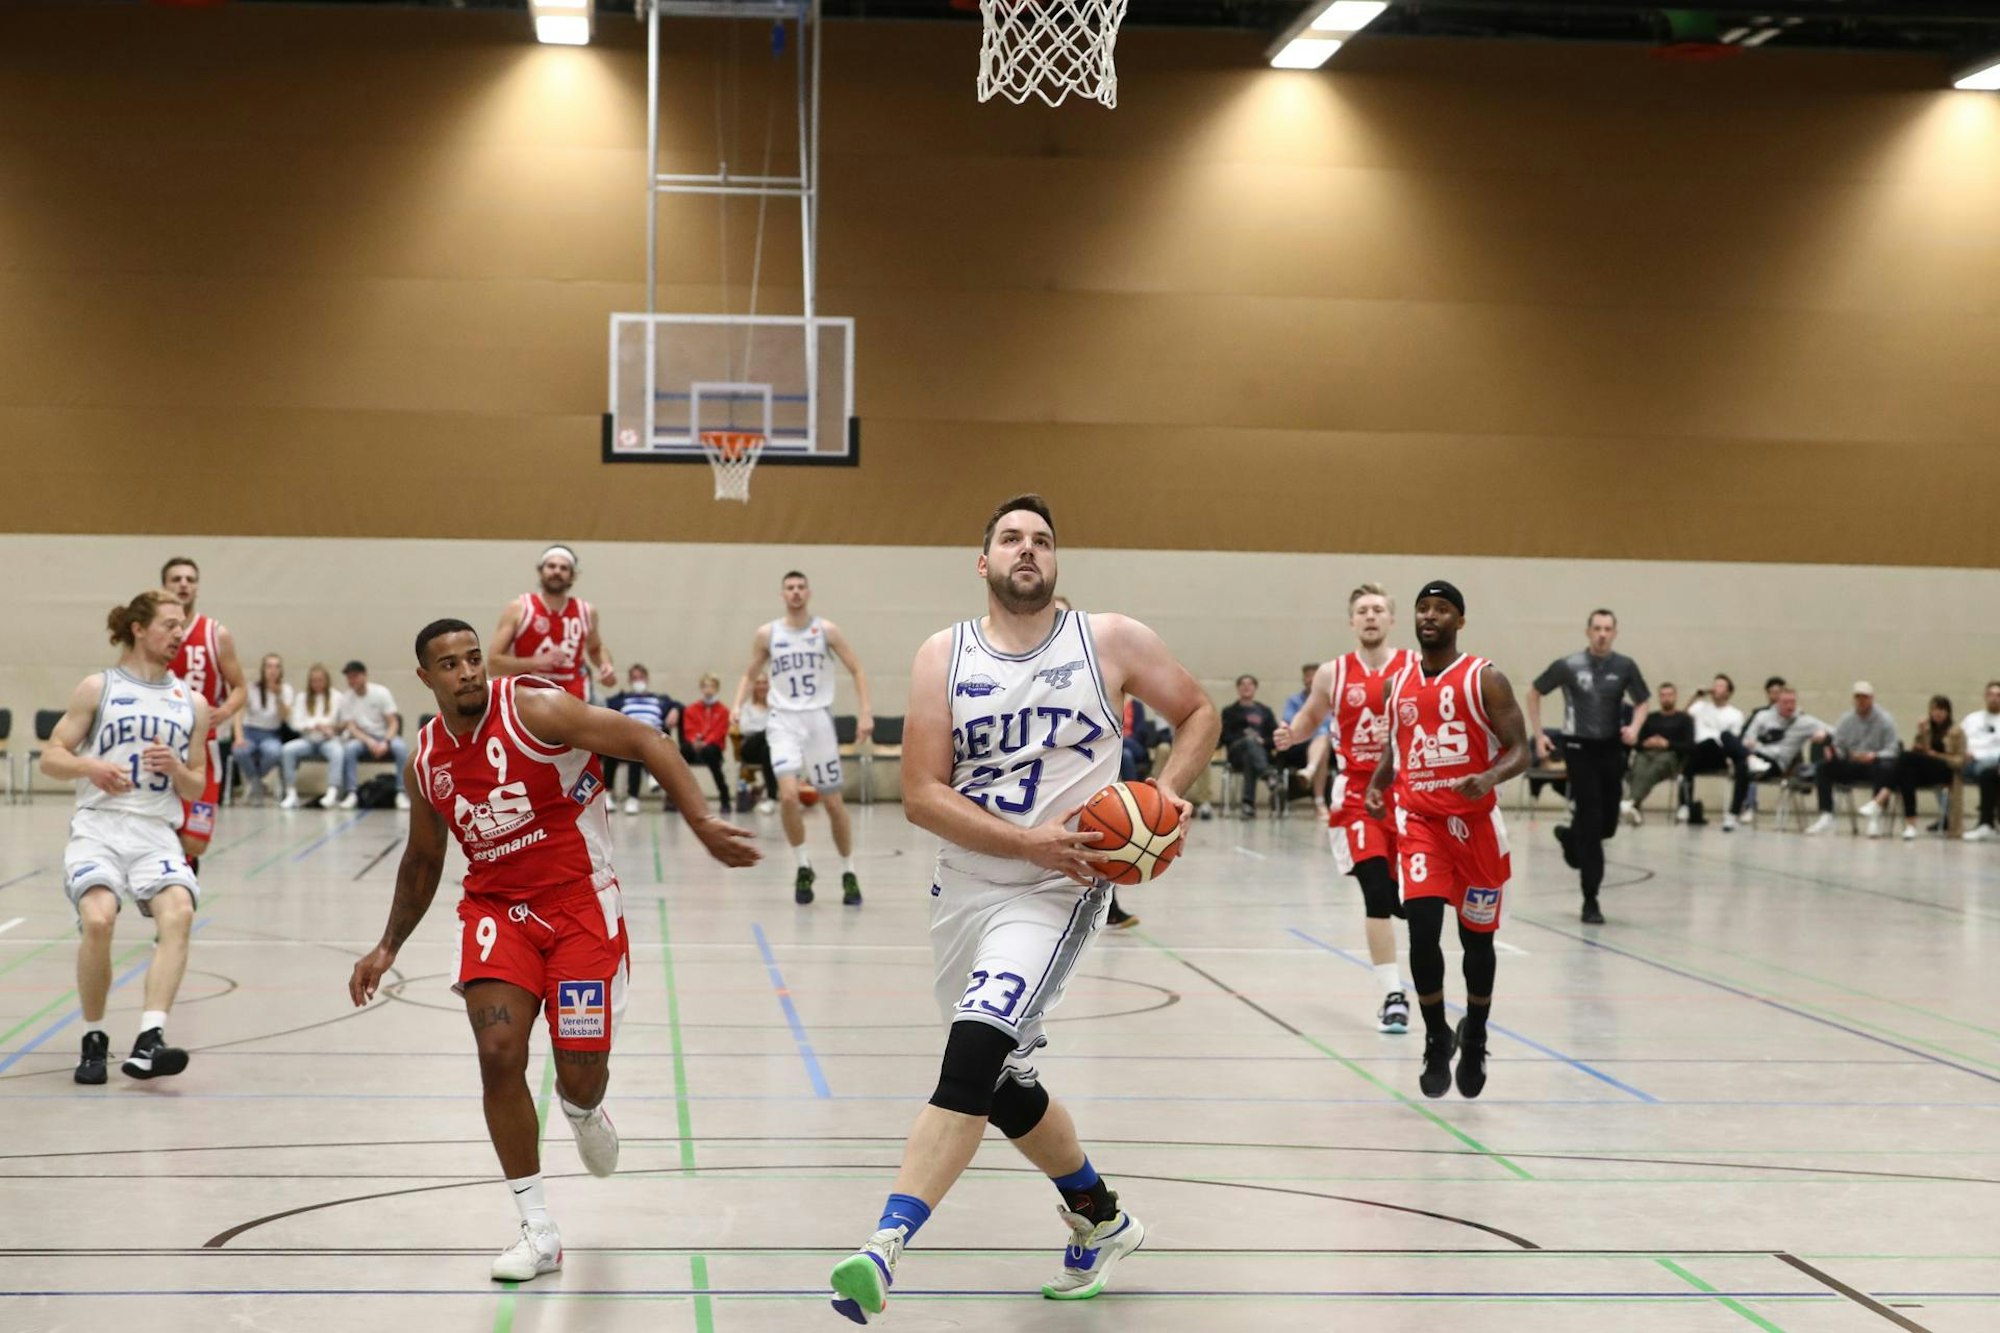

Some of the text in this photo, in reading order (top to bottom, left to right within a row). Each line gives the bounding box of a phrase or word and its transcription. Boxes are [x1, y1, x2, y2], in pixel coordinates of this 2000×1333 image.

[562, 617, 581, 640] 10
[185, 645, 206, 670] 15
[789, 674, 816, 698] 15
[1439, 685, 1455, 721] 8
[128, 753, 169, 793] 15
[486, 736, 507, 784] 9
[814, 759, 840, 785] 15
[961, 757, 1043, 816] 23
[473, 828, 547, 862] orgmann
[1410, 852, 1428, 883] 8
[476, 916, 497, 962] 9
[959, 970, 1027, 1017] 23
[560, 1027, 603, 1036] Volksbank
[562, 1016, 599, 1026] Vereinte
